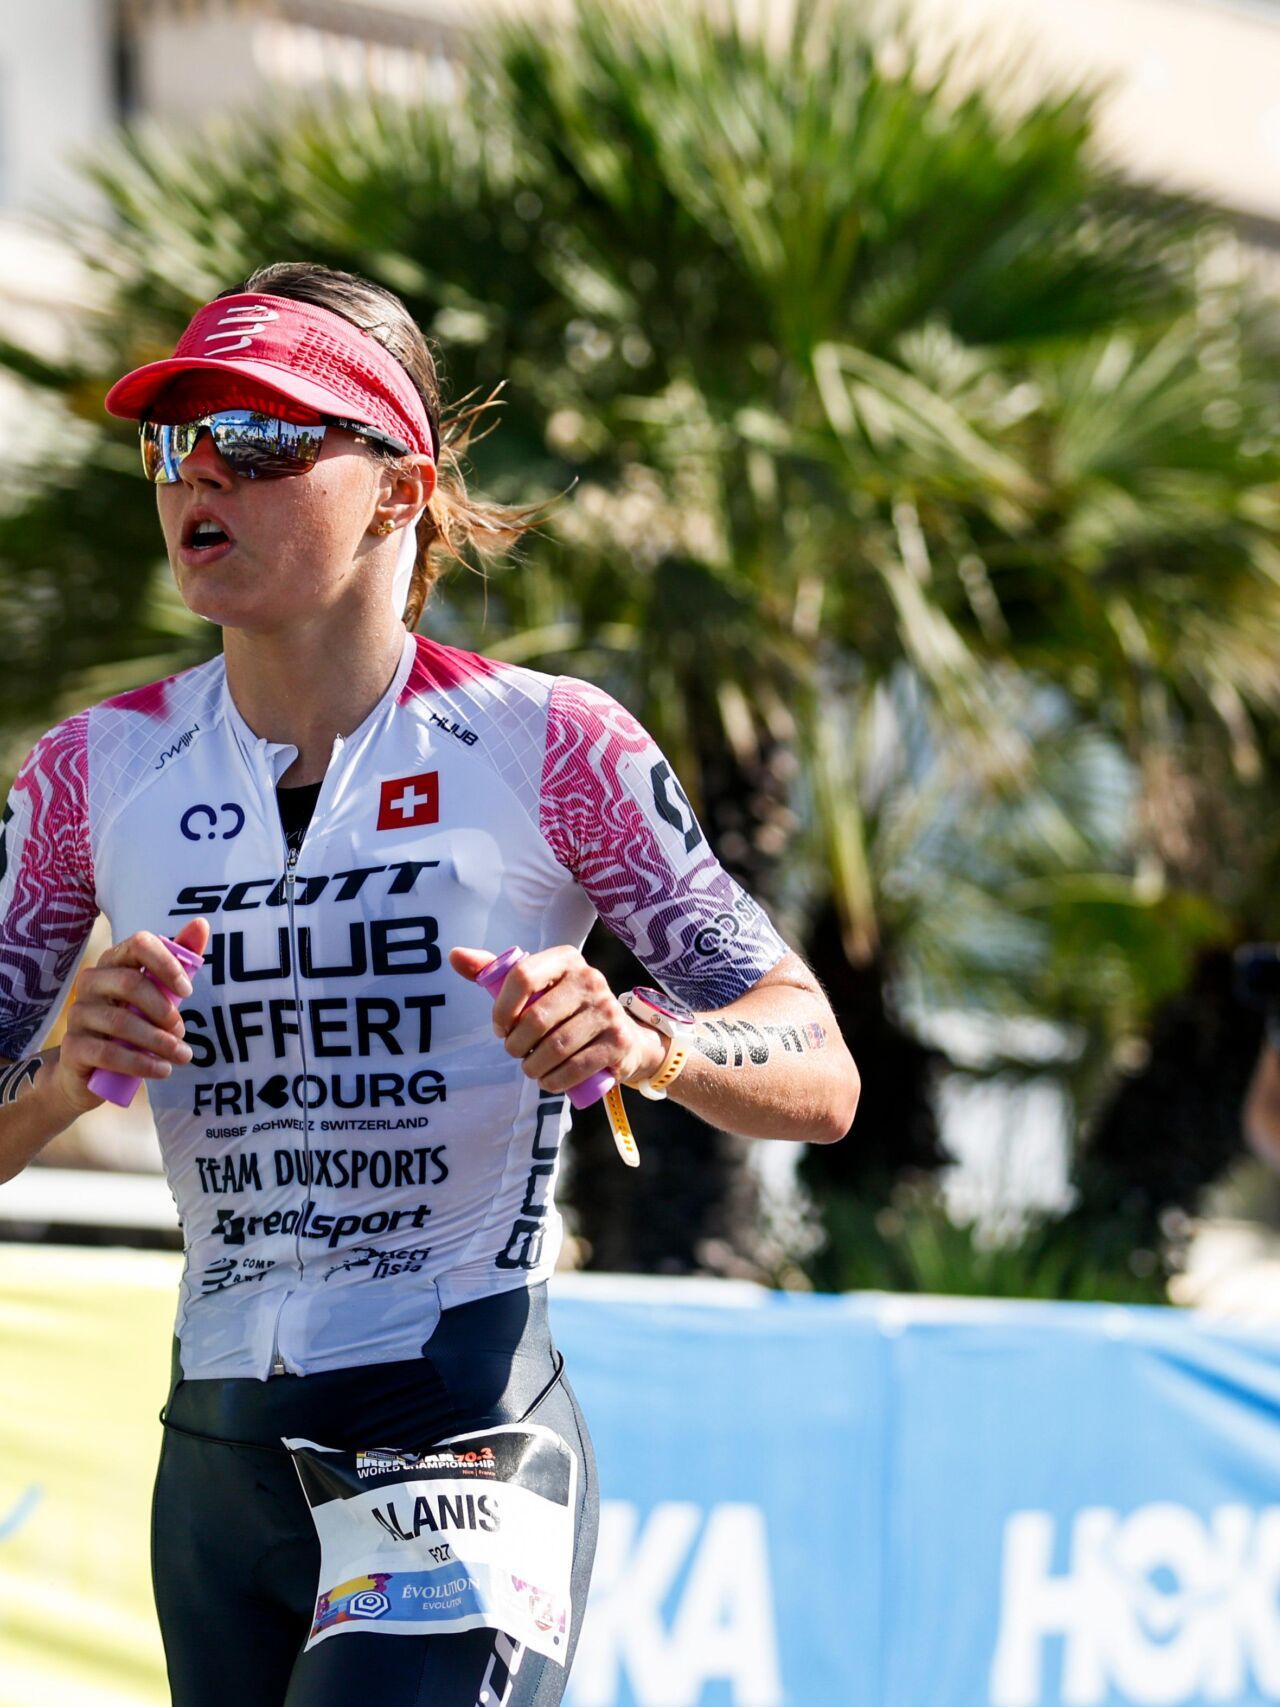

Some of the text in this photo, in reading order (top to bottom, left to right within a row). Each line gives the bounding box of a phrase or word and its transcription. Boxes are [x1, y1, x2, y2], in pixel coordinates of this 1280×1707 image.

[429, 713, 478, 746] HUUB
[168, 861, 440, 916] SCOTT
[180, 994, 446, 1068] SIFFERT
[205, 1126, 247, 1139] SUISSE
[320, 1116, 429, 1132] SWITZERLAND
[195, 1144, 449, 1194] TEAM DUXSPORTS
[495, 1089, 565, 1269] UUB
[247, 1200, 433, 1248] realsport
[242, 1257, 276, 1269] COMP
[357, 1465, 401, 1479] WORLD
[428, 1543, 451, 1563] F27
[402, 1577, 481, 1599] ÉVOLUTION
